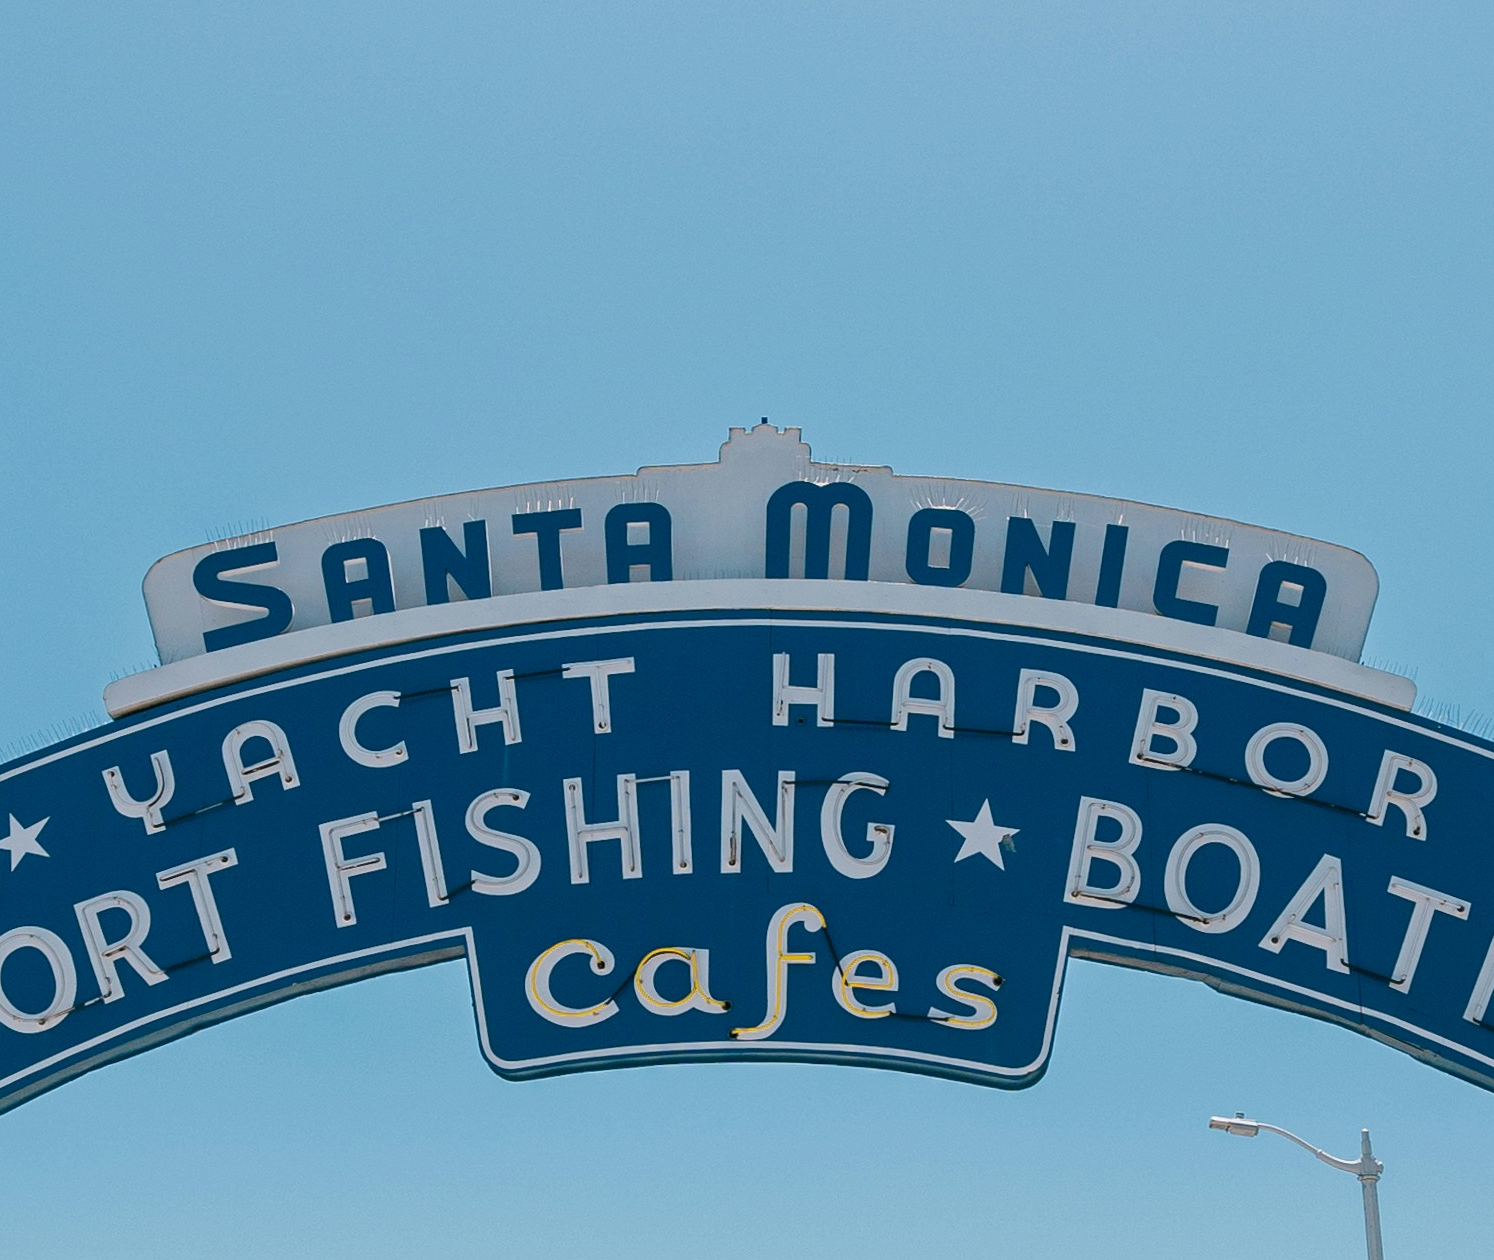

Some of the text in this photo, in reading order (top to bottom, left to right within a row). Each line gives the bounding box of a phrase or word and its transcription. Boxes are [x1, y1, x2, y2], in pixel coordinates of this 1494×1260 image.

[192, 480, 1328, 653] SANTA MONICA
[103, 652, 1439, 841] YACHT HARBOR
[318, 769, 895, 928] FISHING
